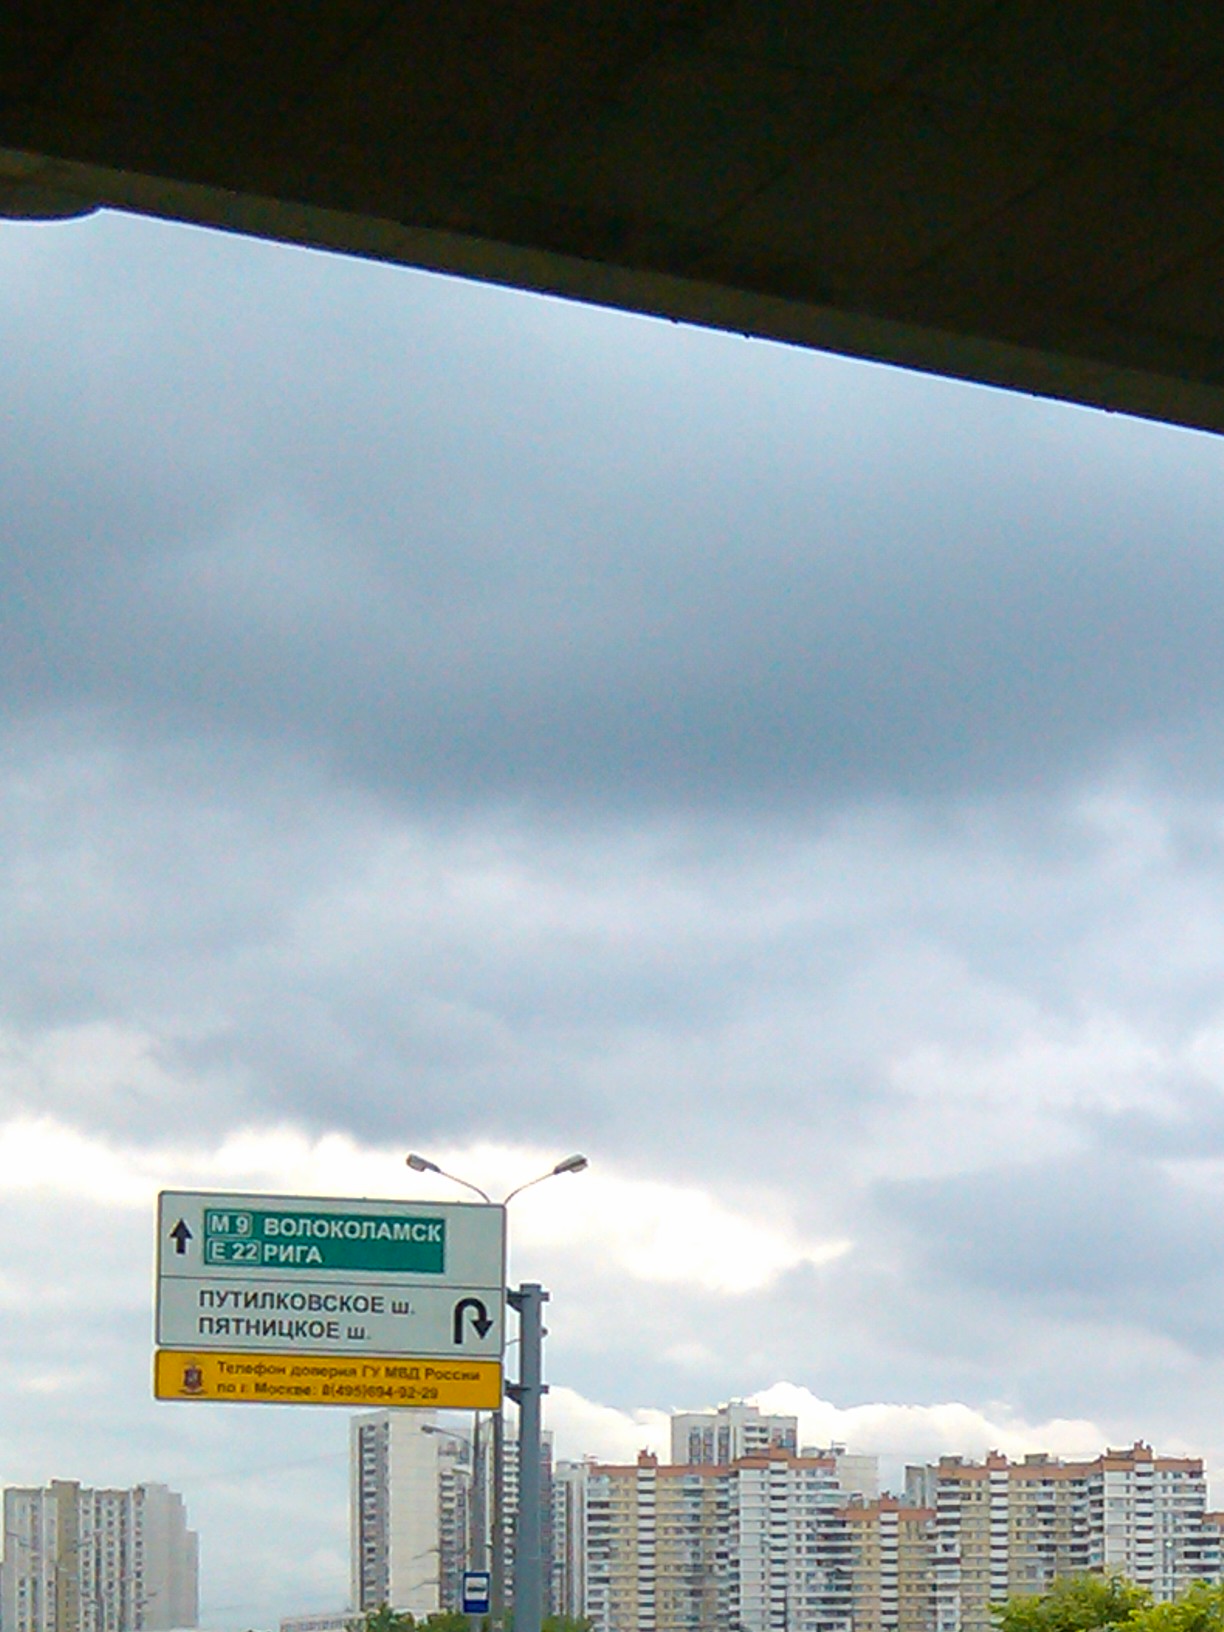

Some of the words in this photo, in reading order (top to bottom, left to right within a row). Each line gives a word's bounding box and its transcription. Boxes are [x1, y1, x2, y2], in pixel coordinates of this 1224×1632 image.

[236, 1219, 249, 1234] 9
[264, 1218, 441, 1242] ВОЛОКОЛАМСК
[232, 1244, 258, 1260] 22
[264, 1245, 323, 1264] РИГА
[199, 1290, 384, 1313] ПУТИЛКОВСКОЕ
[199, 1317, 340, 1340] ПЯТНИЦКОЕ
[217, 1361, 286, 1377] Телефон
[290, 1366, 357, 1380] доверия
[362, 1366, 380, 1378] ГУ
[385, 1367, 420, 1380] МВД
[424, 1369, 481, 1381] России
[217, 1384, 236, 1394] по
